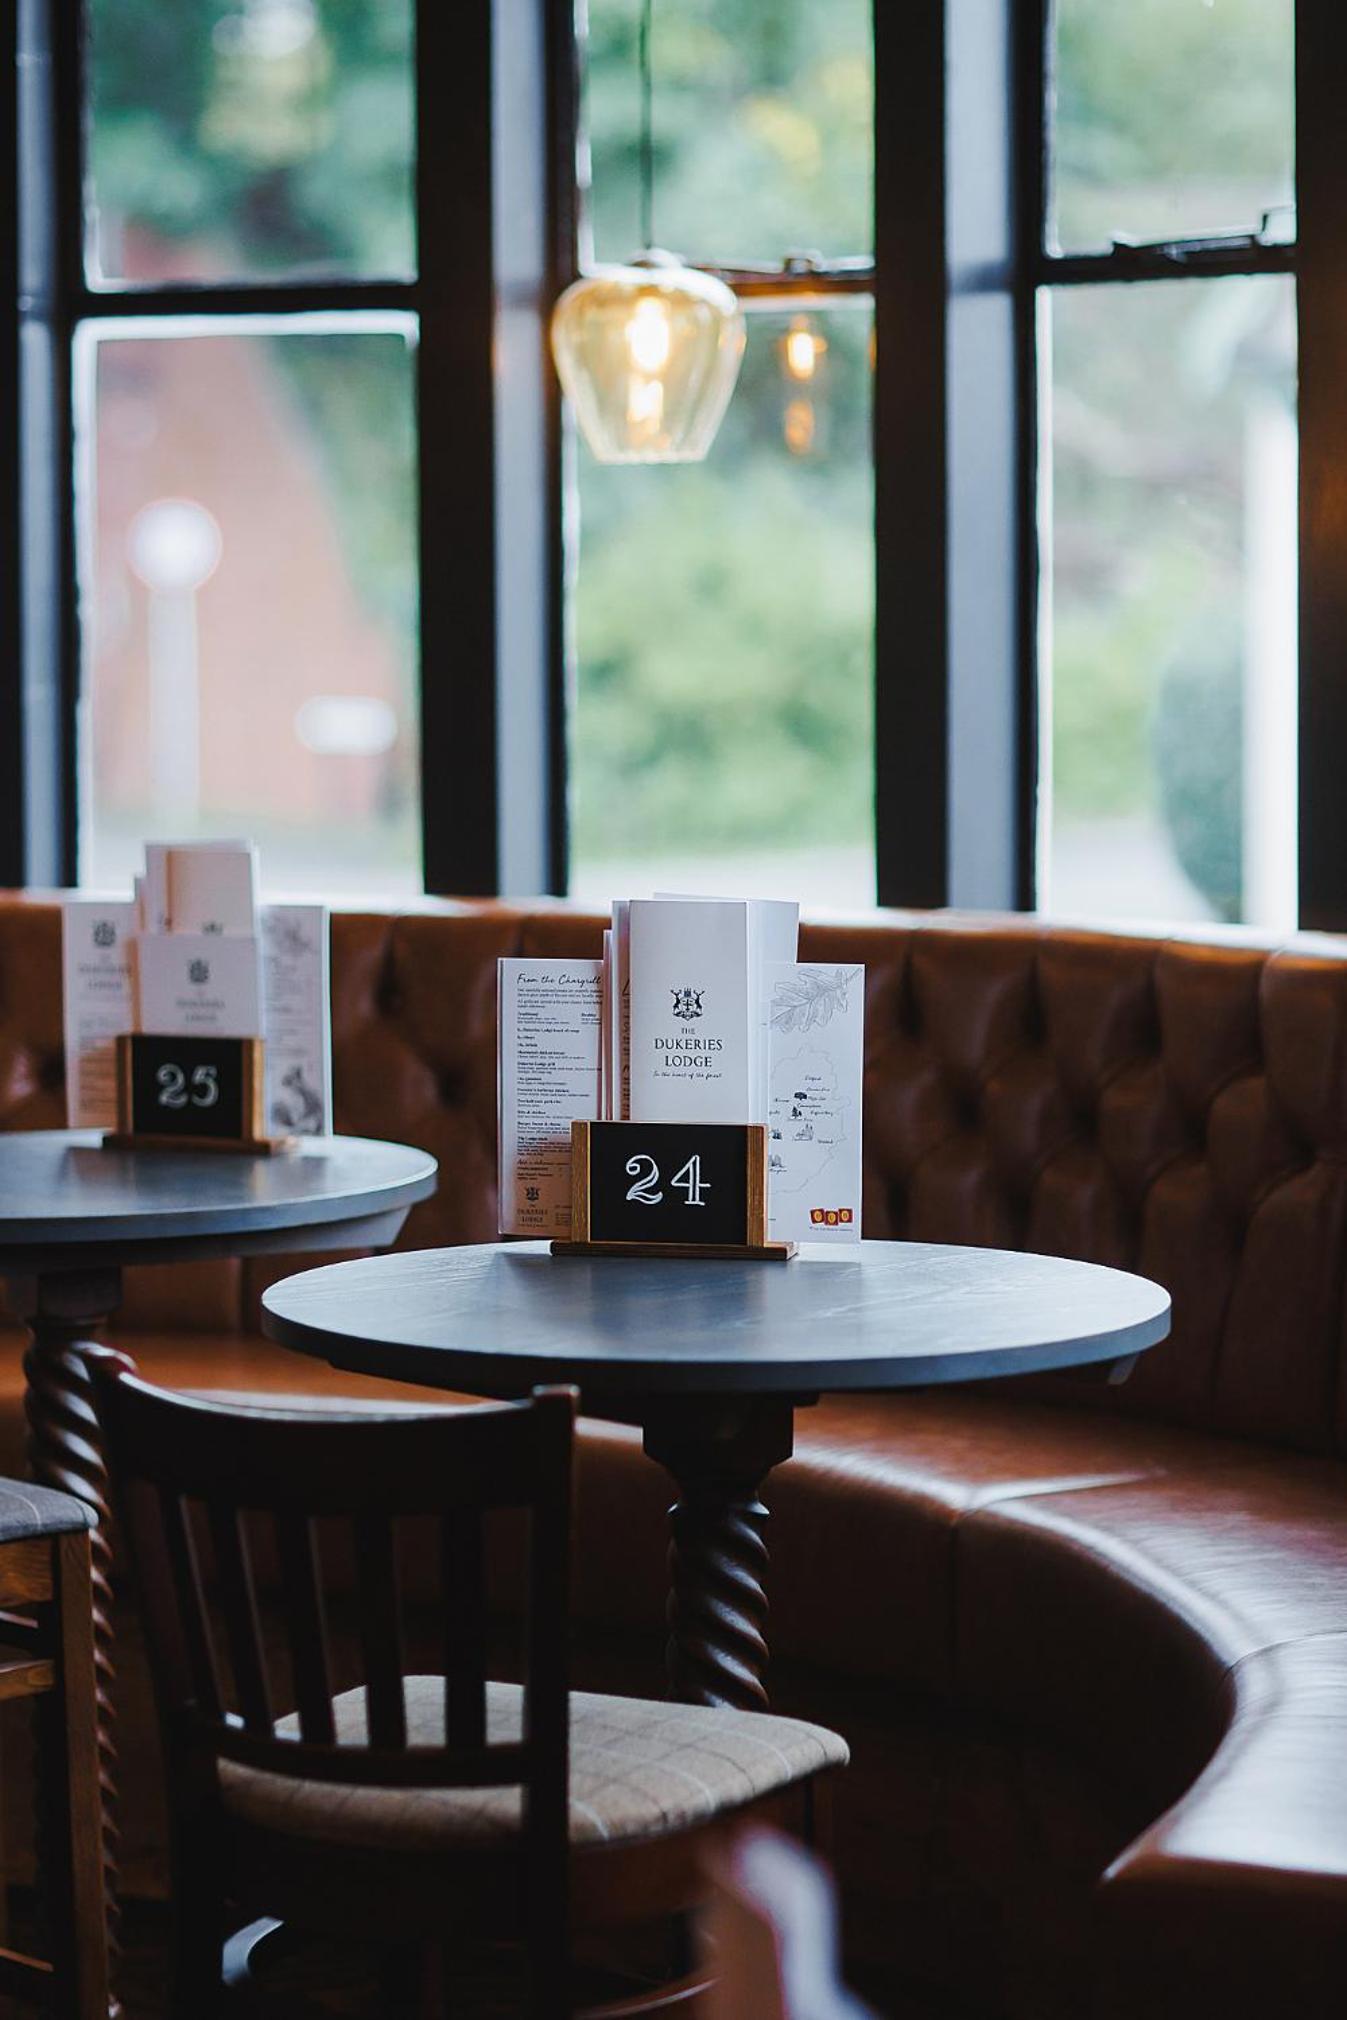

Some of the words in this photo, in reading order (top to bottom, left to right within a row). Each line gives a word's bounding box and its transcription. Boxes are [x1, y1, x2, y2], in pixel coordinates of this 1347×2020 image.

[516, 973, 539, 985] From
[541, 975, 555, 984] the
[681, 1027, 696, 1035] THE
[654, 1038, 723, 1051] DUKERIES
[664, 1055, 712, 1068] LODGE
[157, 1063, 219, 1108] 25
[625, 1154, 712, 1206] 24
